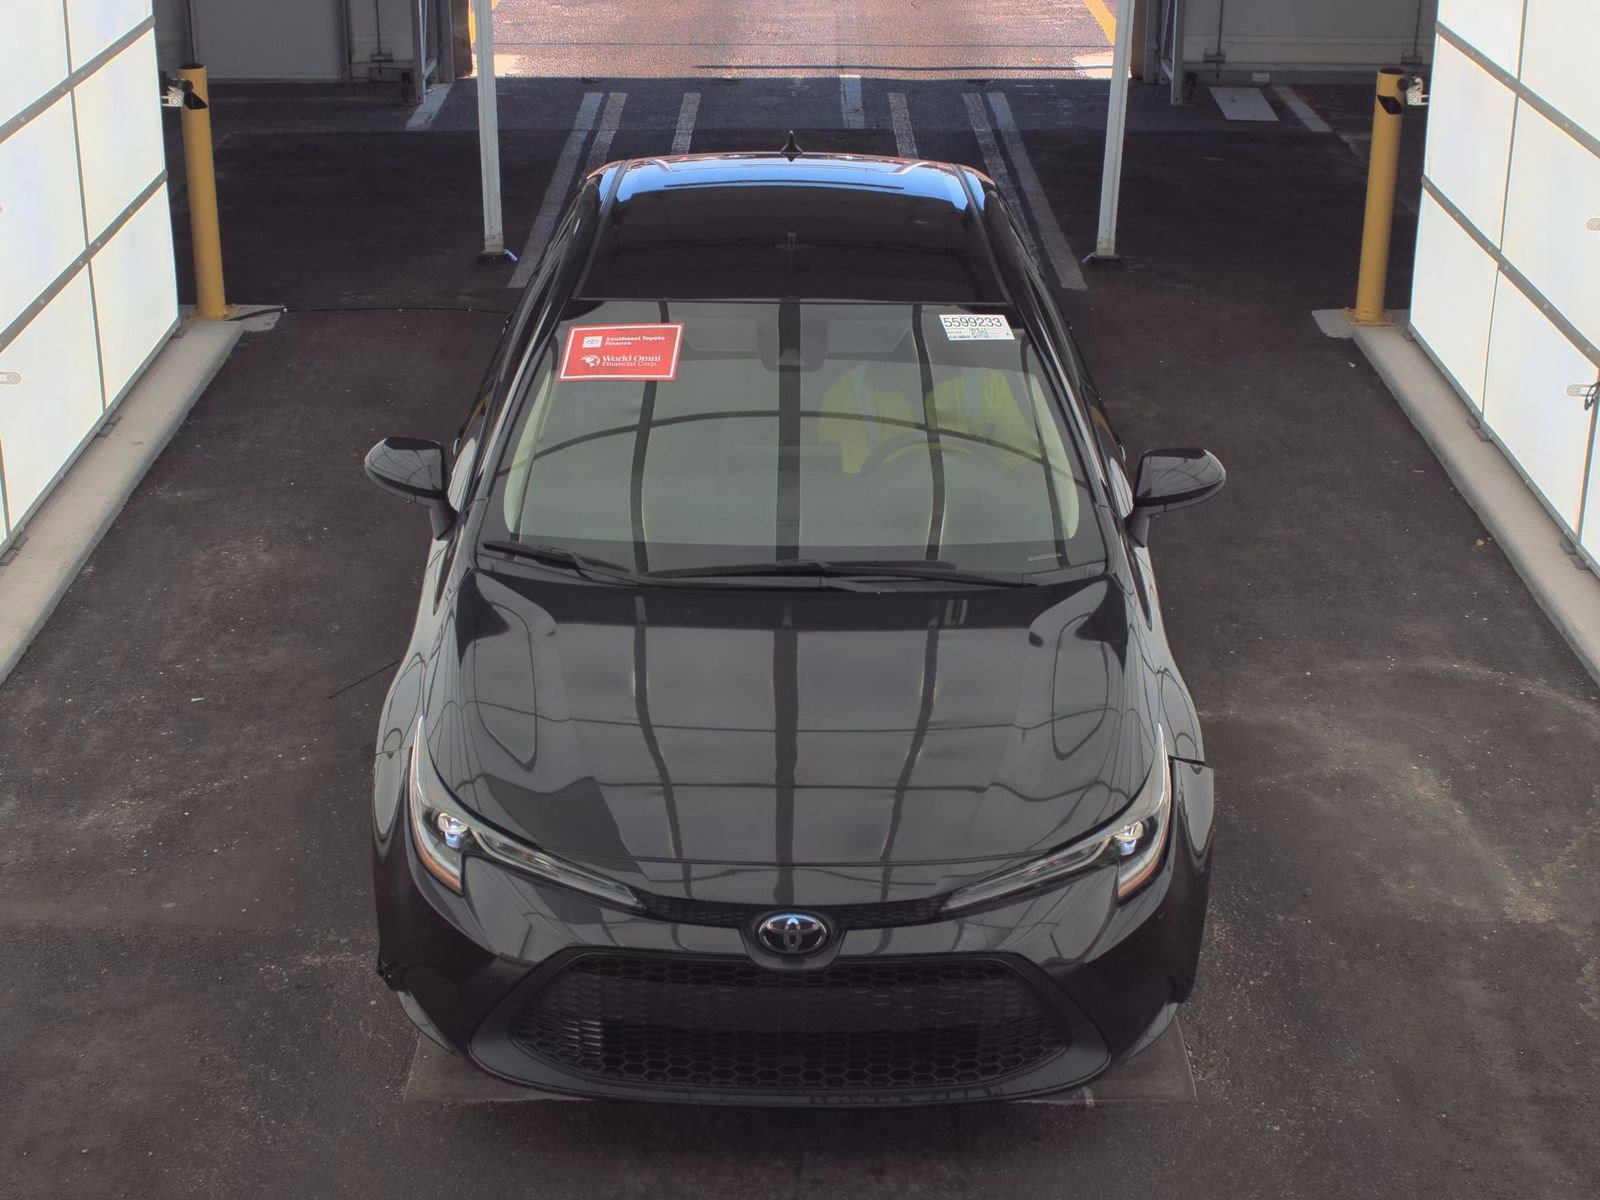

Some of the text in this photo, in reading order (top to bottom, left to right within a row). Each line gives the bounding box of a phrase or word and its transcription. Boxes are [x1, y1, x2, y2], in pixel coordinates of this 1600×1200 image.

[943, 317, 1003, 328] 5599233
[602, 354, 661, 362] World Omni
